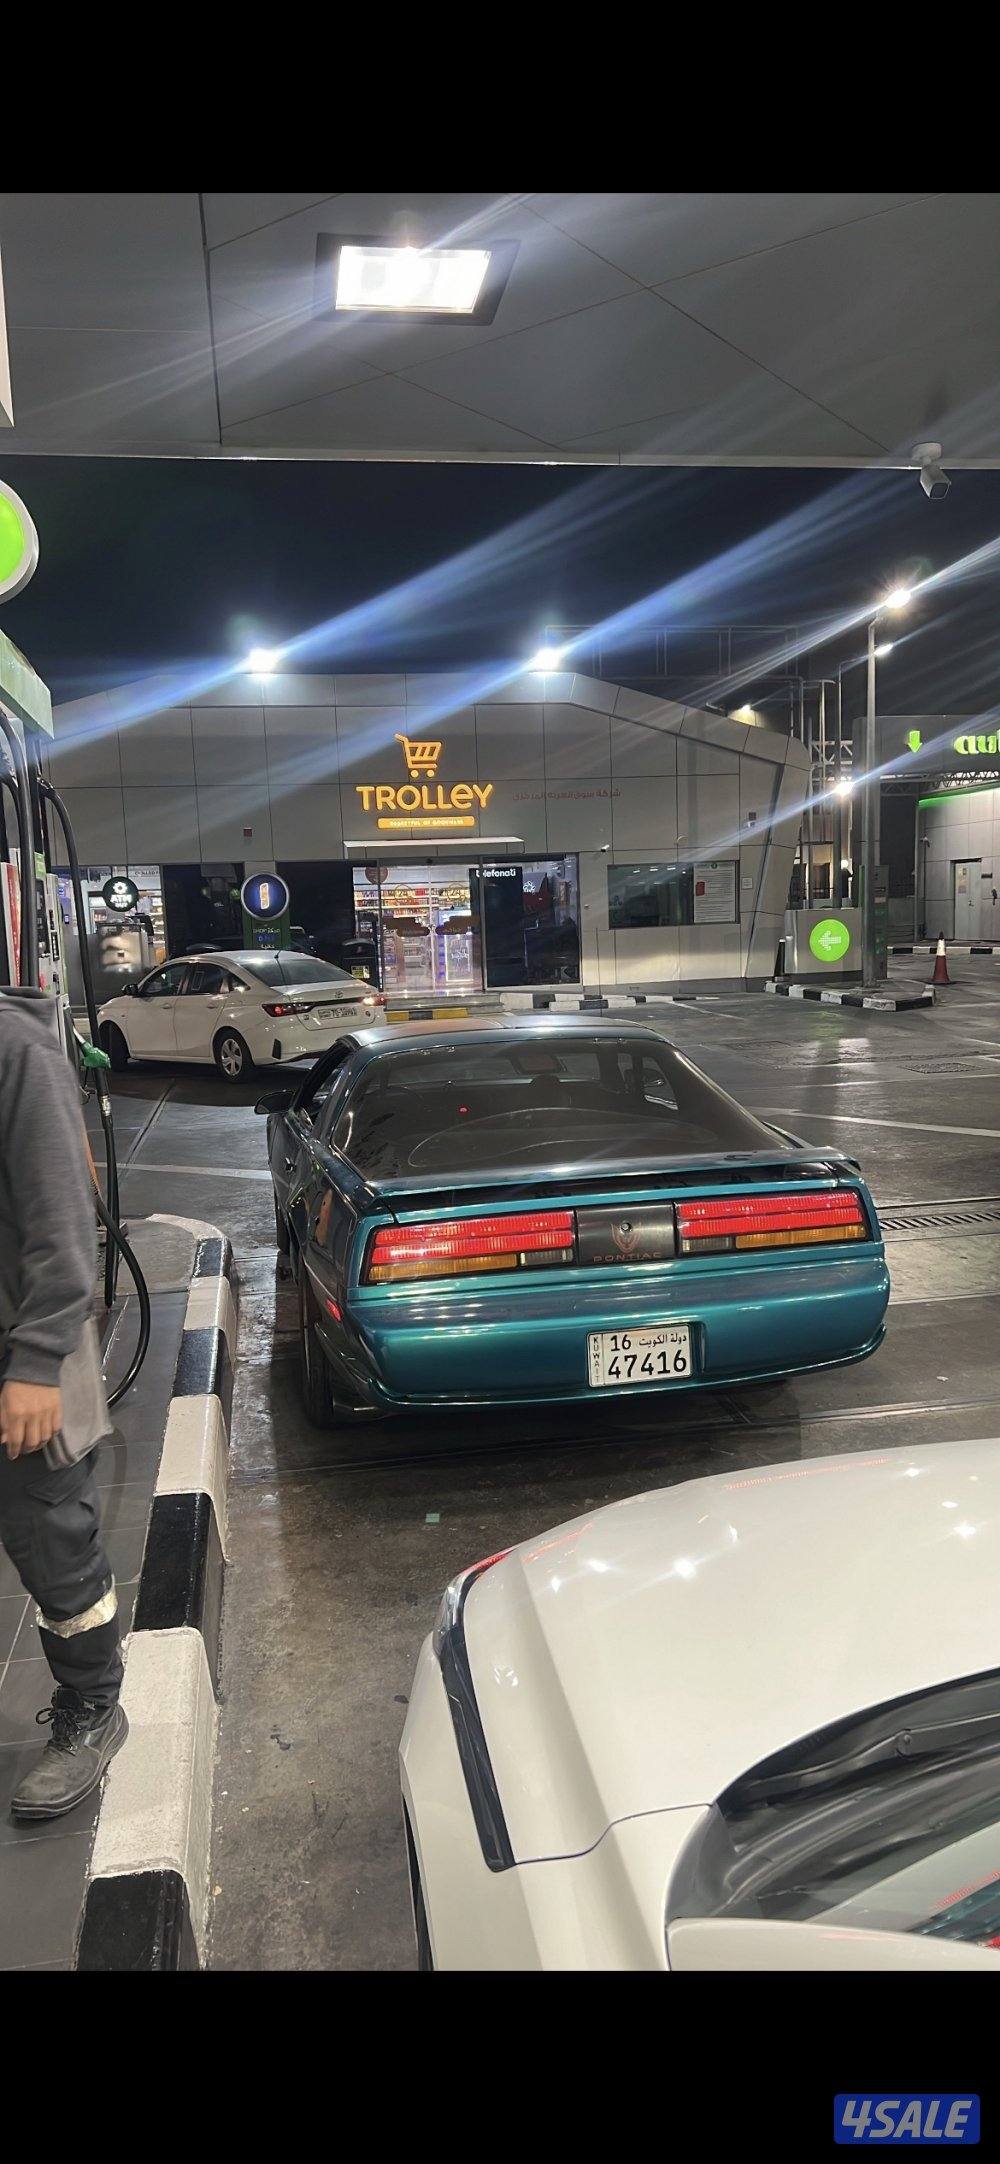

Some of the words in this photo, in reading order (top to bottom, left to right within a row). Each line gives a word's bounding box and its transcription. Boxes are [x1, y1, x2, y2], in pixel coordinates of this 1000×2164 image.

[954, 730, 1000, 755] au
[593, 1251, 662, 1263] PONTIAC
[610, 1334, 632, 1352] 16
[638, 1334, 668, 1349] الكويت
[670, 1332, 687, 1345] دولة
[608, 1349, 687, 1379] 47416
